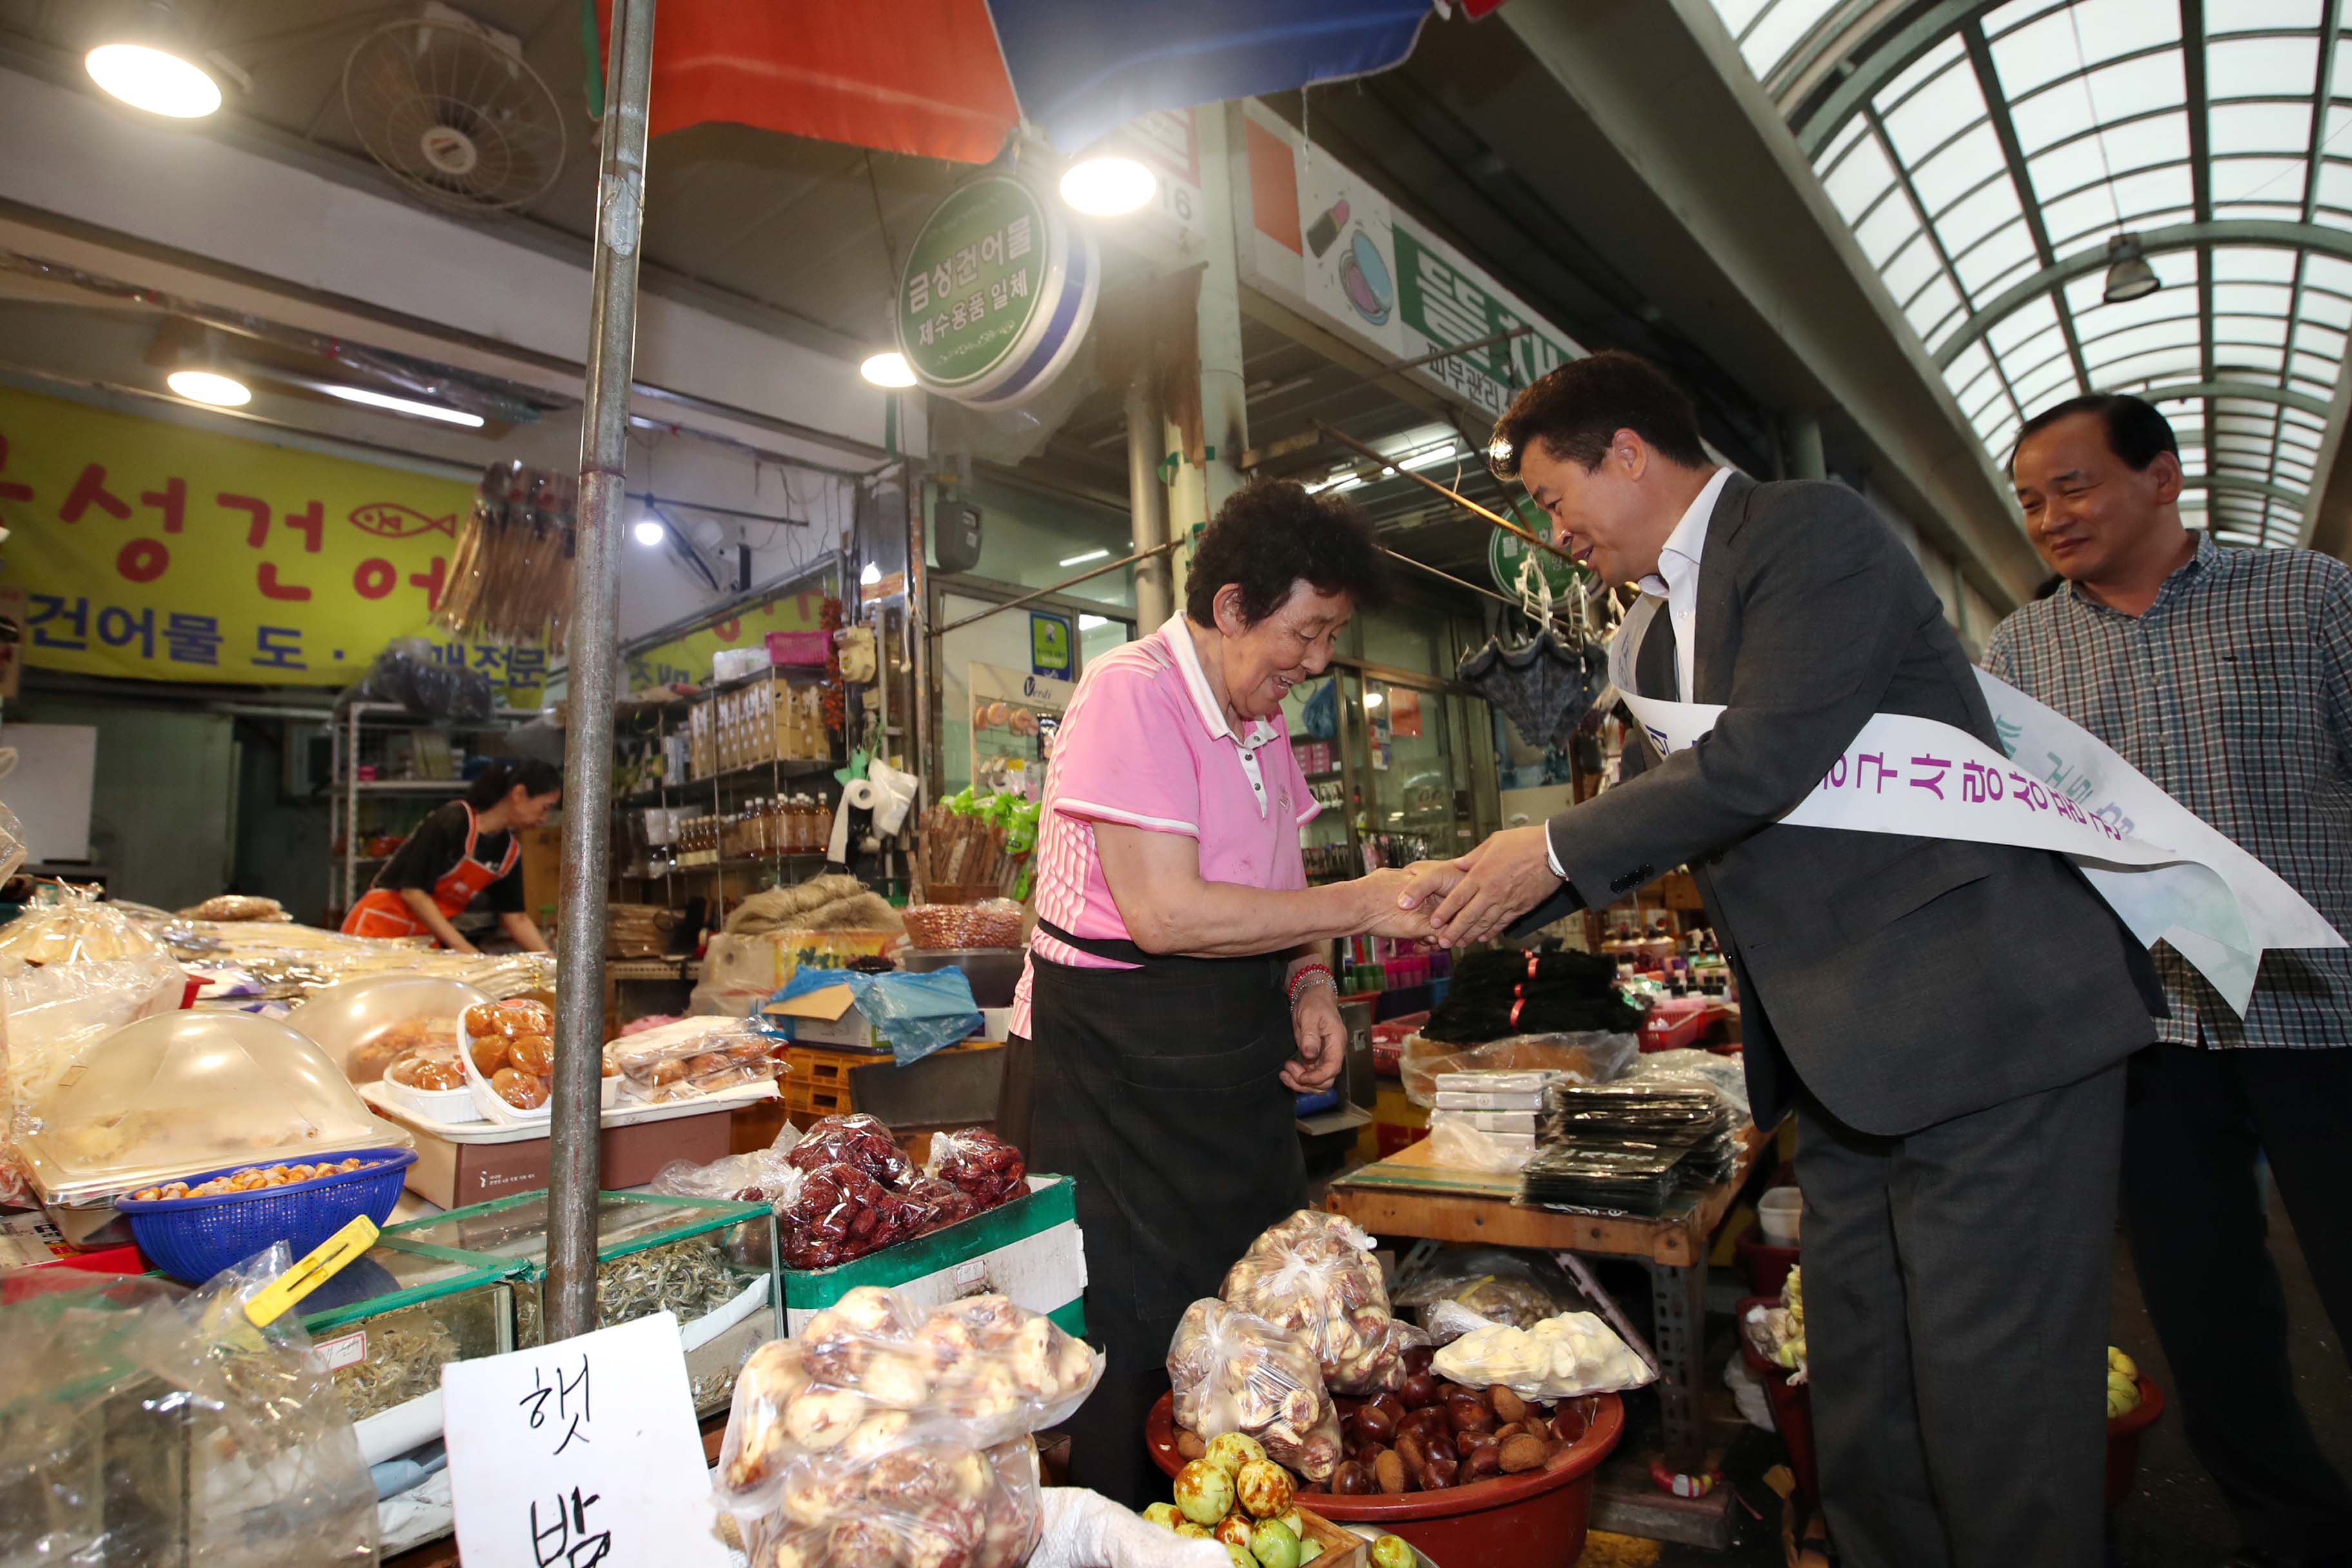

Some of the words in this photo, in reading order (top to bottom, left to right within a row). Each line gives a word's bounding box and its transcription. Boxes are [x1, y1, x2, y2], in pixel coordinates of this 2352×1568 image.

[908, 215, 1032, 315] 금성건어물
[918, 290, 986, 346] 제수용품
[990, 268, 1028, 311] 일체
[0, 433, 449, 612] 성건어
[25, 593, 224, 666] 건어물
[1023, 676, 1052, 700] Verdi
[520, 1353, 592, 1455] 햇
[530, 1485, 612, 1568] 밤
